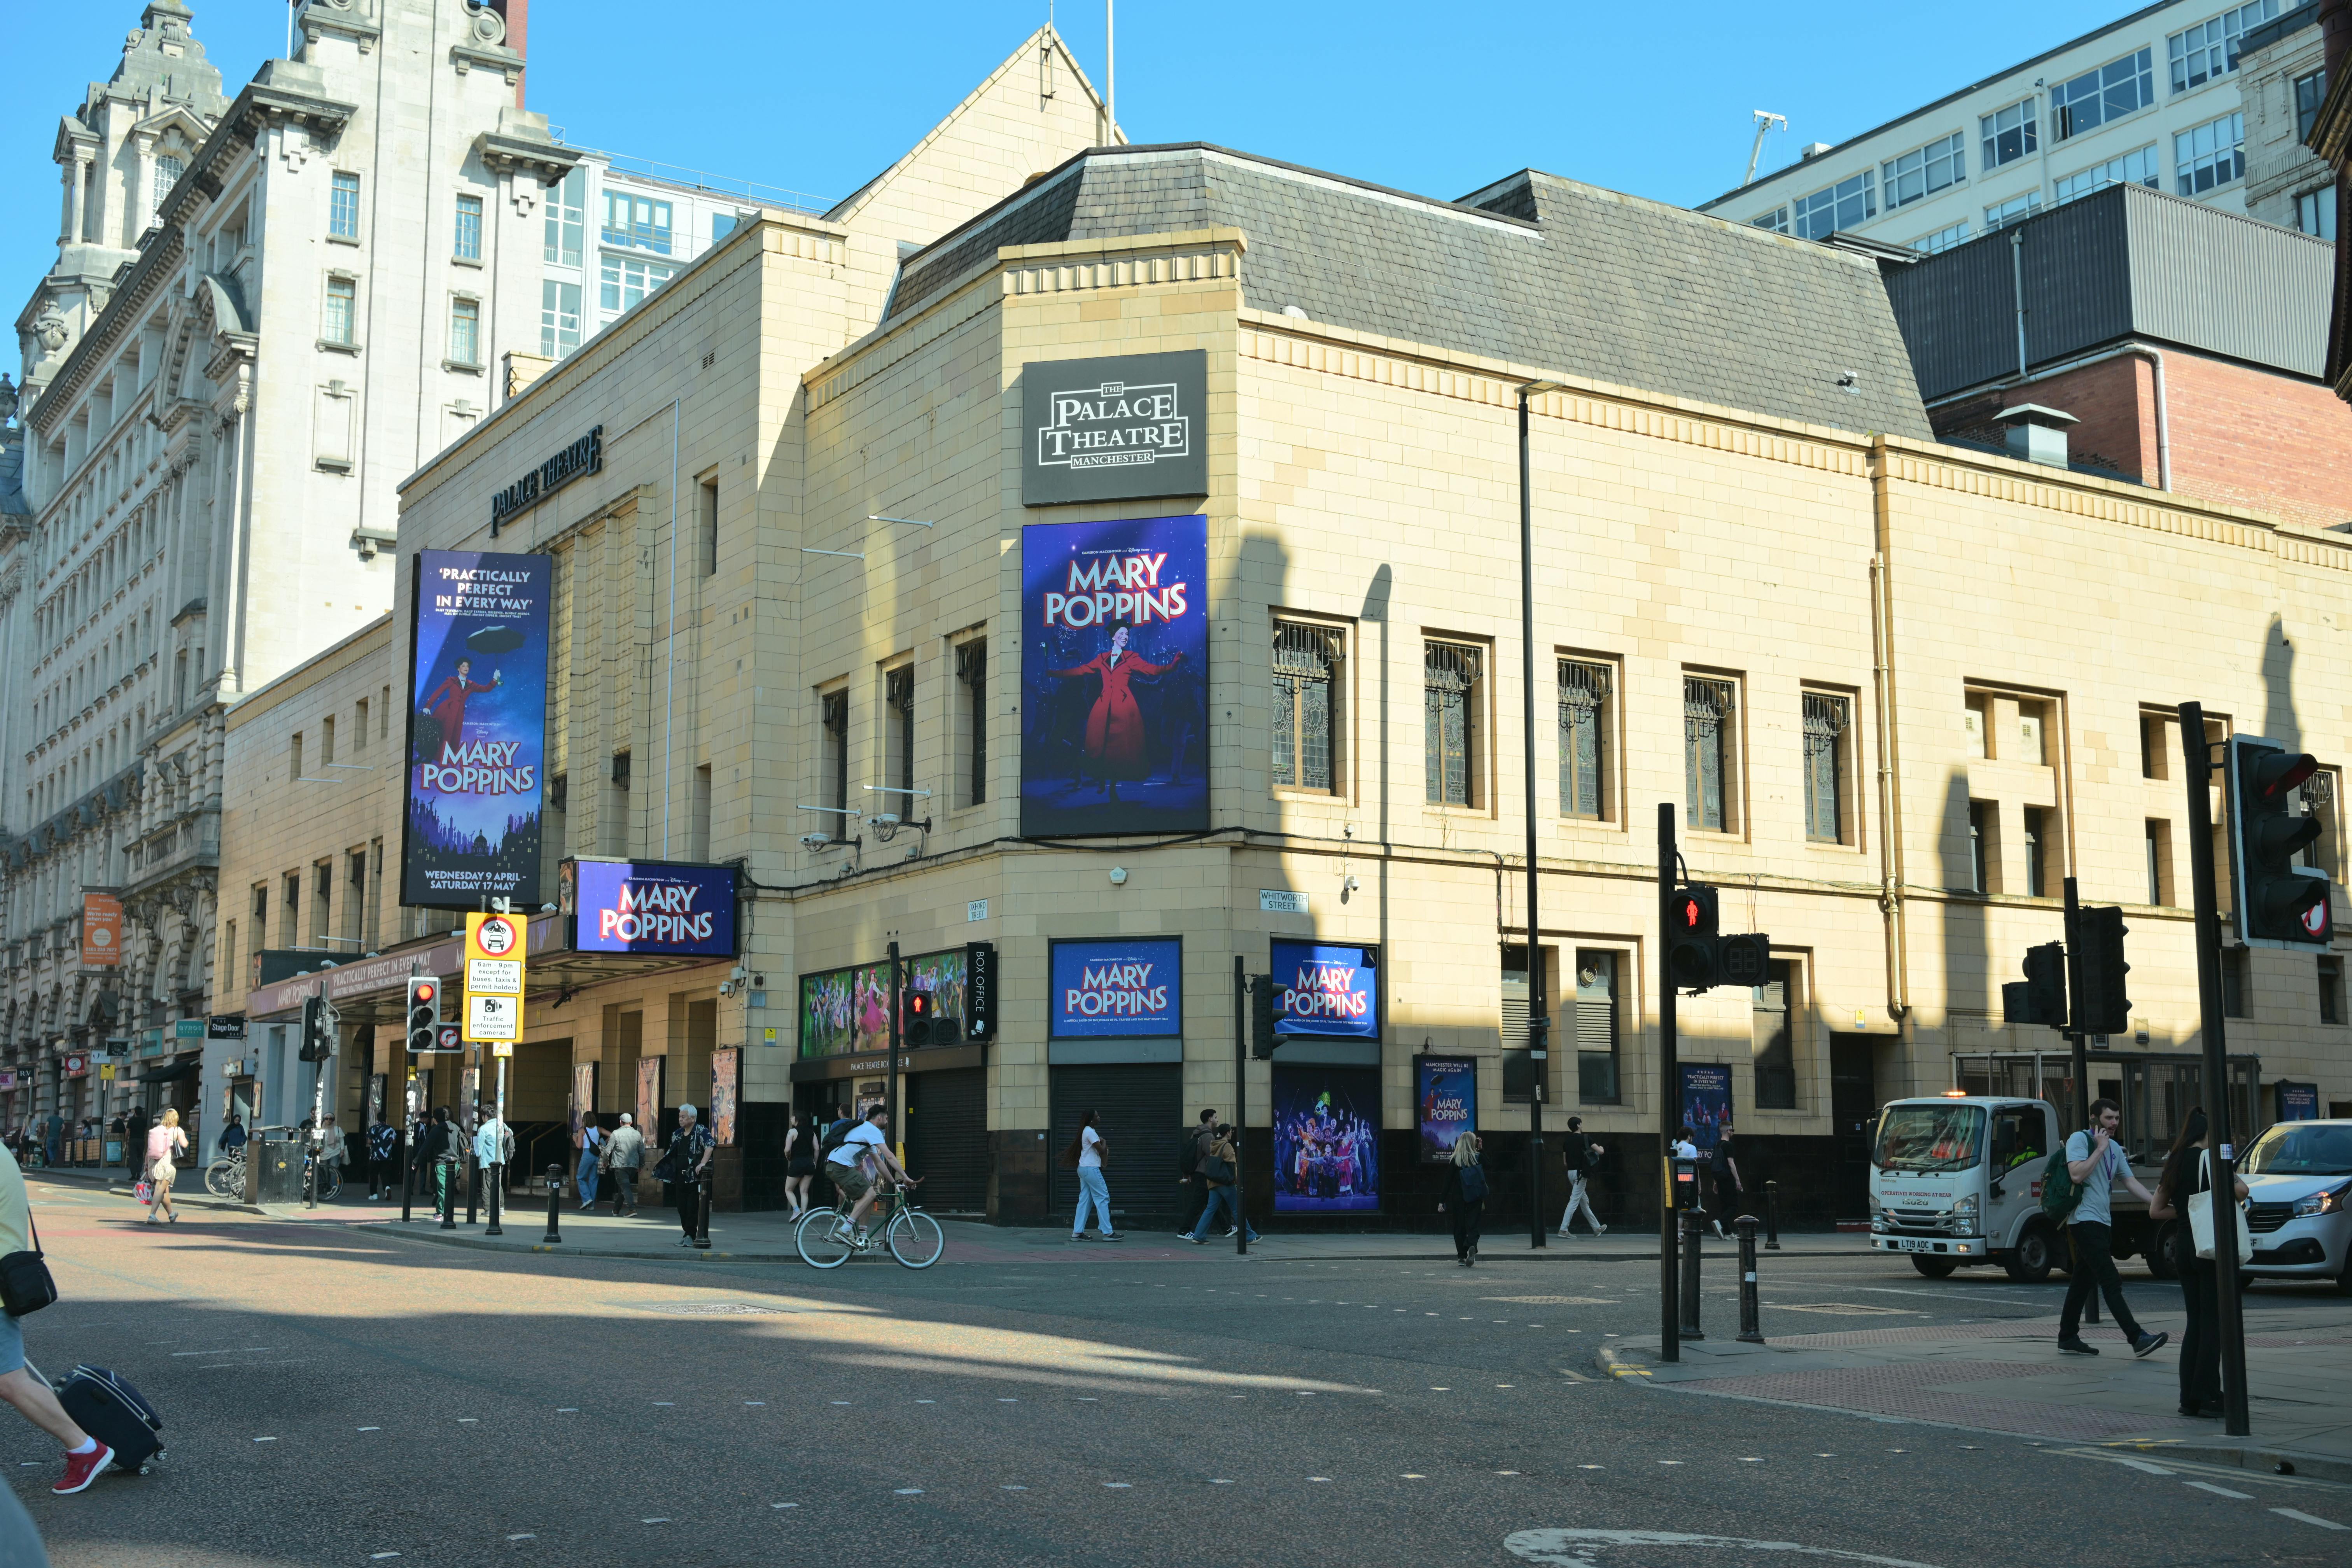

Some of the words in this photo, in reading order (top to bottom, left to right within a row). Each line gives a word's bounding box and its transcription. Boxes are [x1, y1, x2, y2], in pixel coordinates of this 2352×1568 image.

[1056, 394, 1173, 427] PALACE
[1046, 423, 1183, 455] THEATRE
[1073, 453, 1152, 466] MANCHESTER
[489, 469, 539, 538] PALACE
[540, 425, 602, 491] THEATRE
[1068, 553, 1167, 592] MARY
[457, 583, 513, 595] PERFECT
[436, 595, 451, 607] IN
[455, 596, 497, 609] EVERY
[1045, 583, 1186, 628] POPPINS
[440, 739, 520, 768] MARY
[420, 763, 536, 795] POPPINS
[425, 870, 485, 880] WEDNESDAY
[486, 872, 492, 880] 9
[494, 872, 520, 881] APRIL
[430, 880, 480, 890] SATURDAY
[482, 882, 493, 890] 17
[494, 882, 516, 891] MAY
[560, 881, 572, 889] PALACE
[619, 883, 699, 914] MARY
[970, 901, 986, 911] OXFORD
[1261, 891, 1307, 902] WHITWORTH
[1269, 901, 1296, 910] STREET
[600, 909, 713, 943] POPPINS
[368, 961, 390, 979] PERFECT
[391, 959, 398, 974] IN
[399, 954, 417, 972] EVERY
[418, 951, 431, 966] WAY
[456, 946, 465, 968] MA
[976, 951, 984, 973] BOX
[376, 978, 390, 987] THRILLING
[390, 975, 398, 984] SPEED
[399, 974, 403, 983] TO
[1083, 963, 1153, 990] MARY
[1297, 965, 1355, 992] MARY
[277, 985, 292, 1007] MARY
[292, 980, 313, 1004] POPPINS
[976, 976, 984, 1012] OFFICE
[1066, 986, 1168, 1015] POPPINS
[1284, 989, 1367, 1018] POPPINS
[212, 1024, 227, 1032] Stage
[851, 1062, 864, 1071] PALACE
[865, 1061, 880, 1069] THEATRE
[1431, 1108, 1467, 1121] POPPINS
[1437, 1098, 1462, 1110] MARY
[1901, 1239, 1915, 1248] LT19
